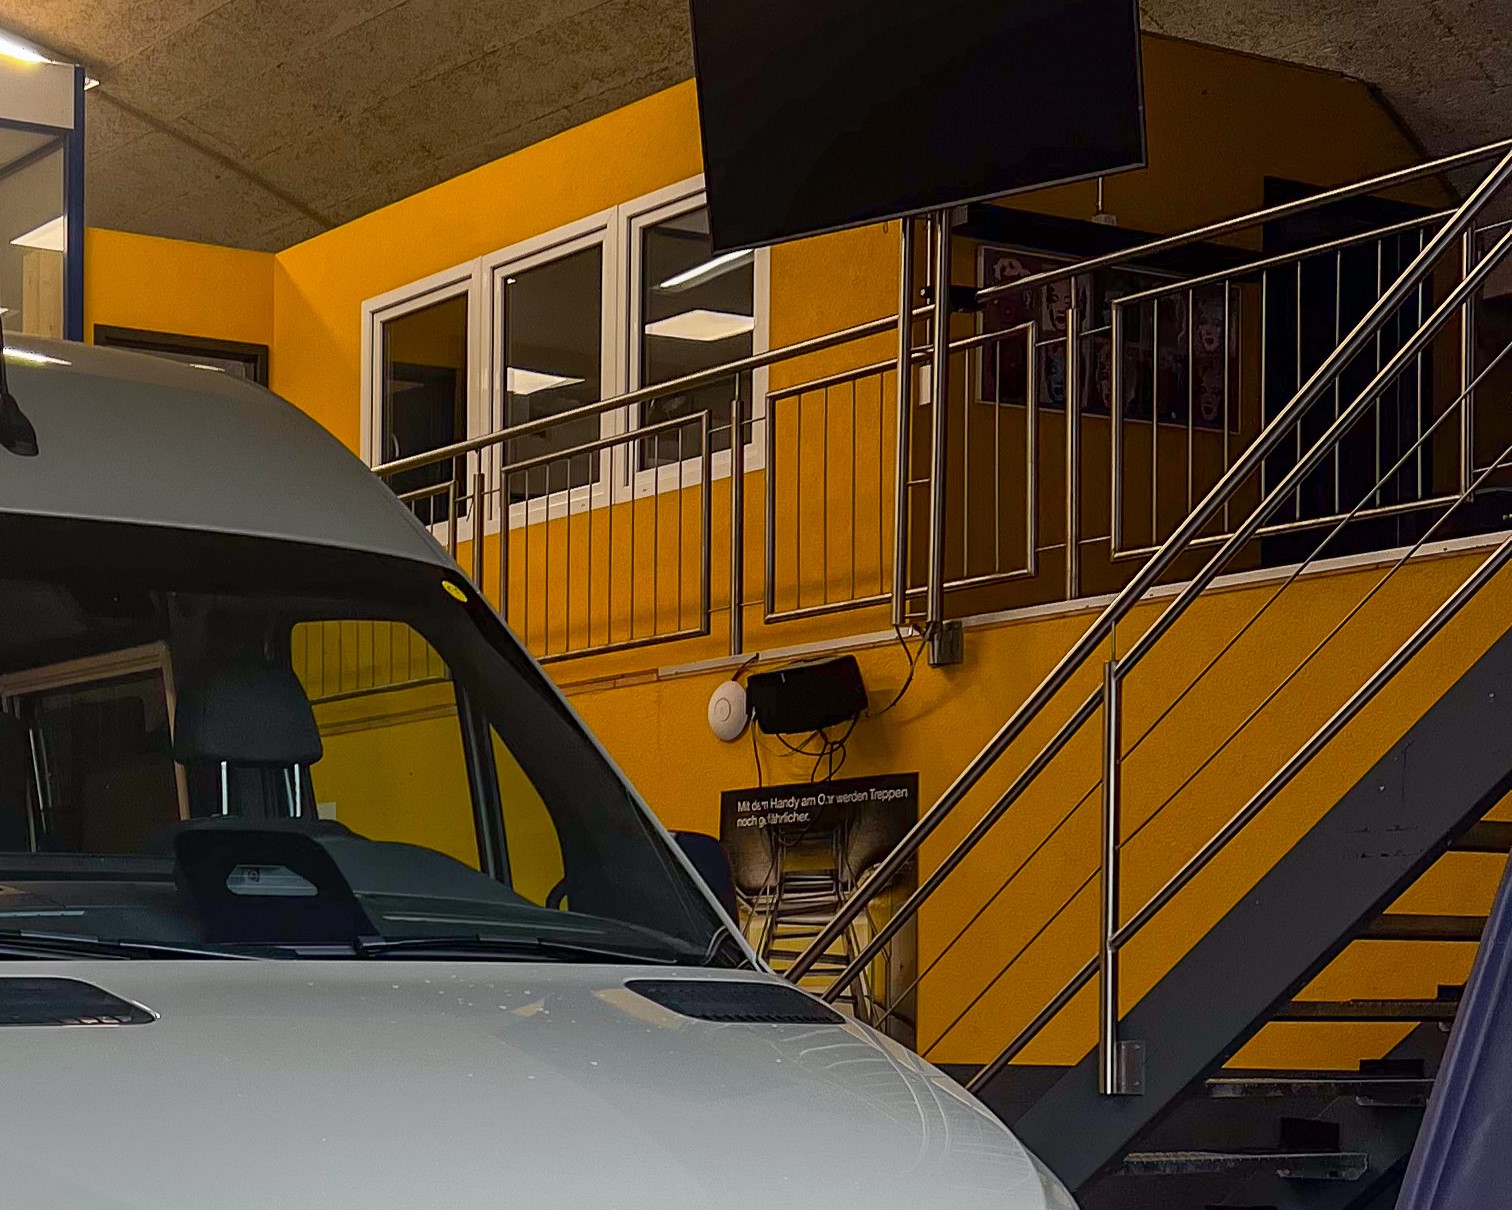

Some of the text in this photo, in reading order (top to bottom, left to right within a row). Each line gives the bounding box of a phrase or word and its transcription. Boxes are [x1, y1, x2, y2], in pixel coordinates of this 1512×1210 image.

[737, 800, 751, 813] Mit
[770, 796, 800, 810] Handy
[801, 797, 816, 807] am
[836, 790, 868, 803] werden
[869, 788, 908, 802] Treppen
[736, 815, 758, 828] noch
